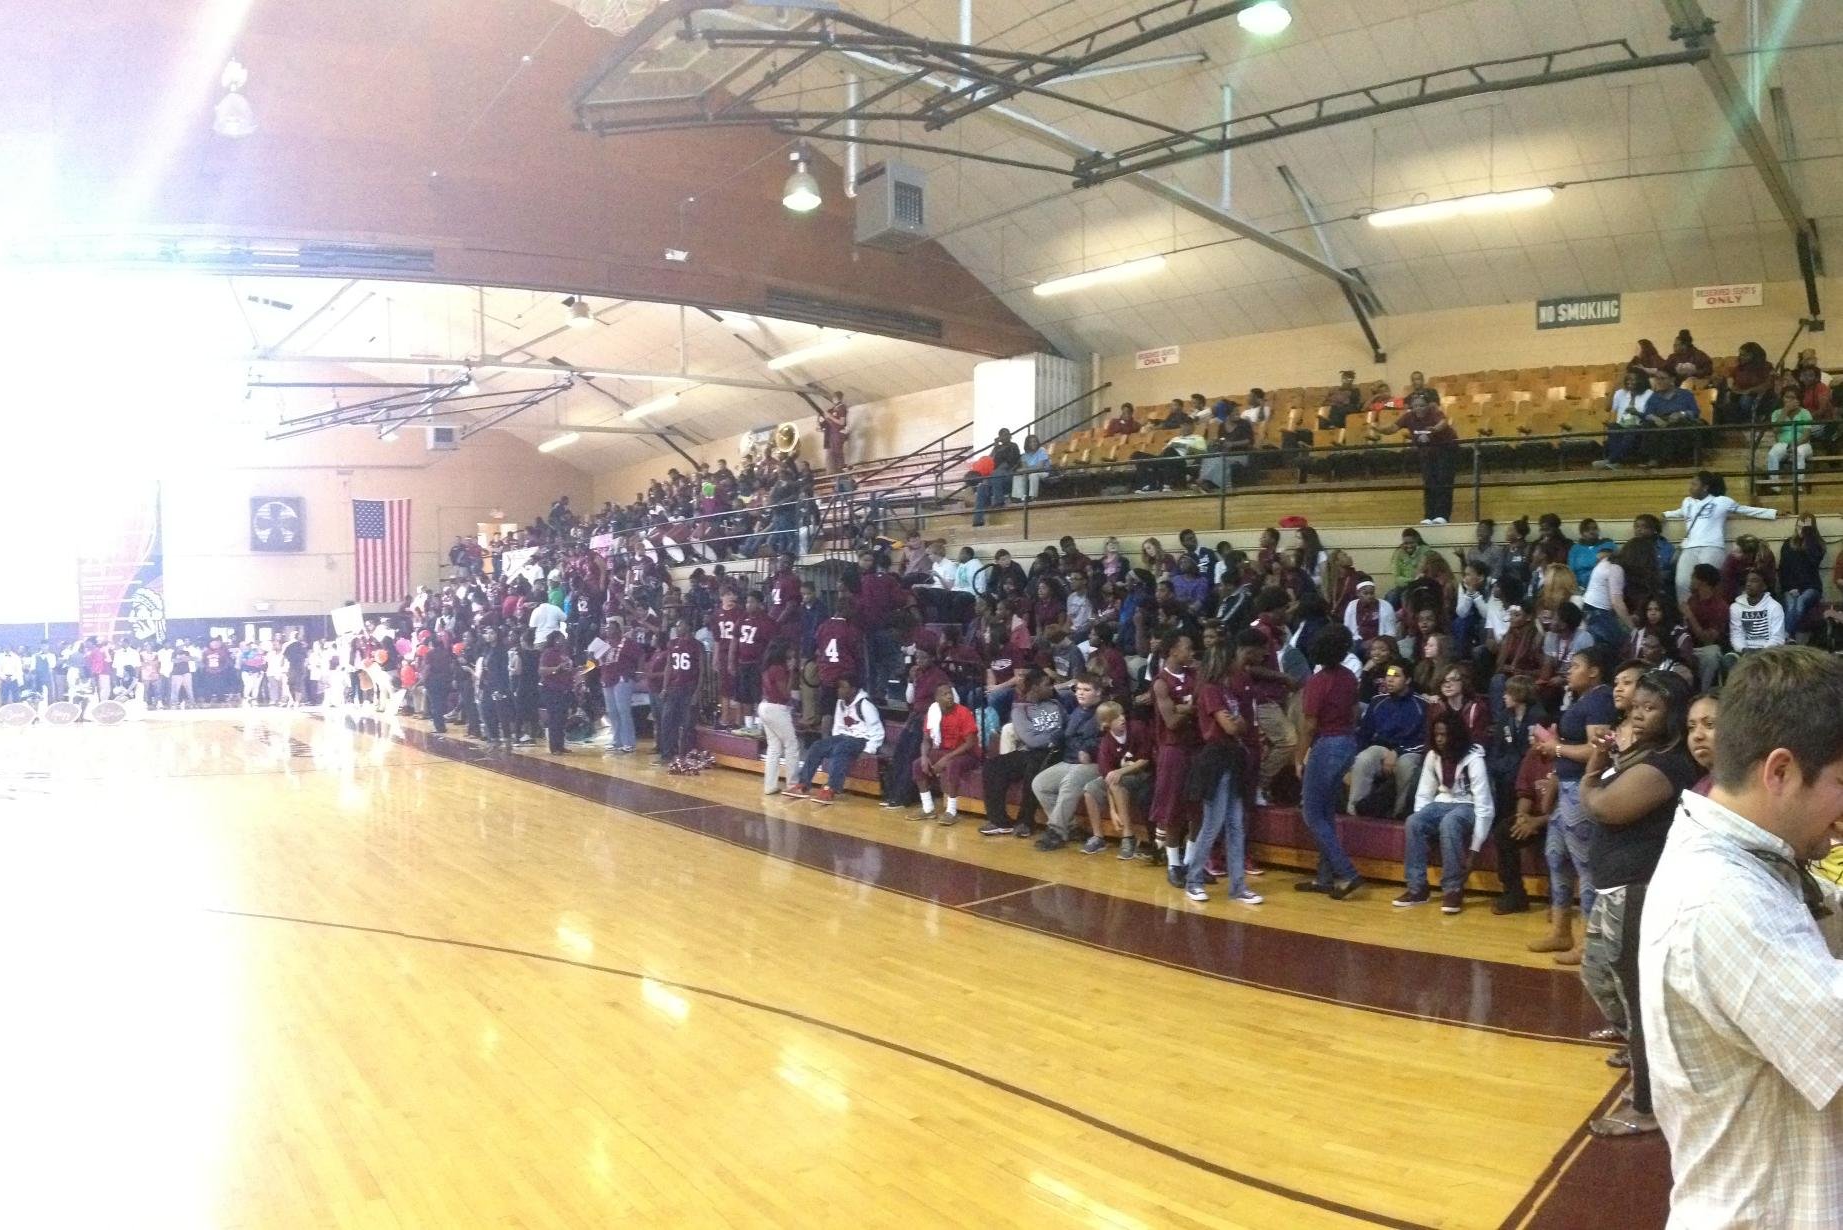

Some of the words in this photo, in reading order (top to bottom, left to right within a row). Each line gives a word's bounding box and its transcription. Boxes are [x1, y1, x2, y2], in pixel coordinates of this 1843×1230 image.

[1707, 295, 1741, 304] ONLY
[1539, 305, 1555, 323] NO
[1557, 300, 1619, 321] SMOKING
[718, 620, 734, 638] 12
[825, 638, 839, 662] 4
[671, 652, 691, 670] 36
